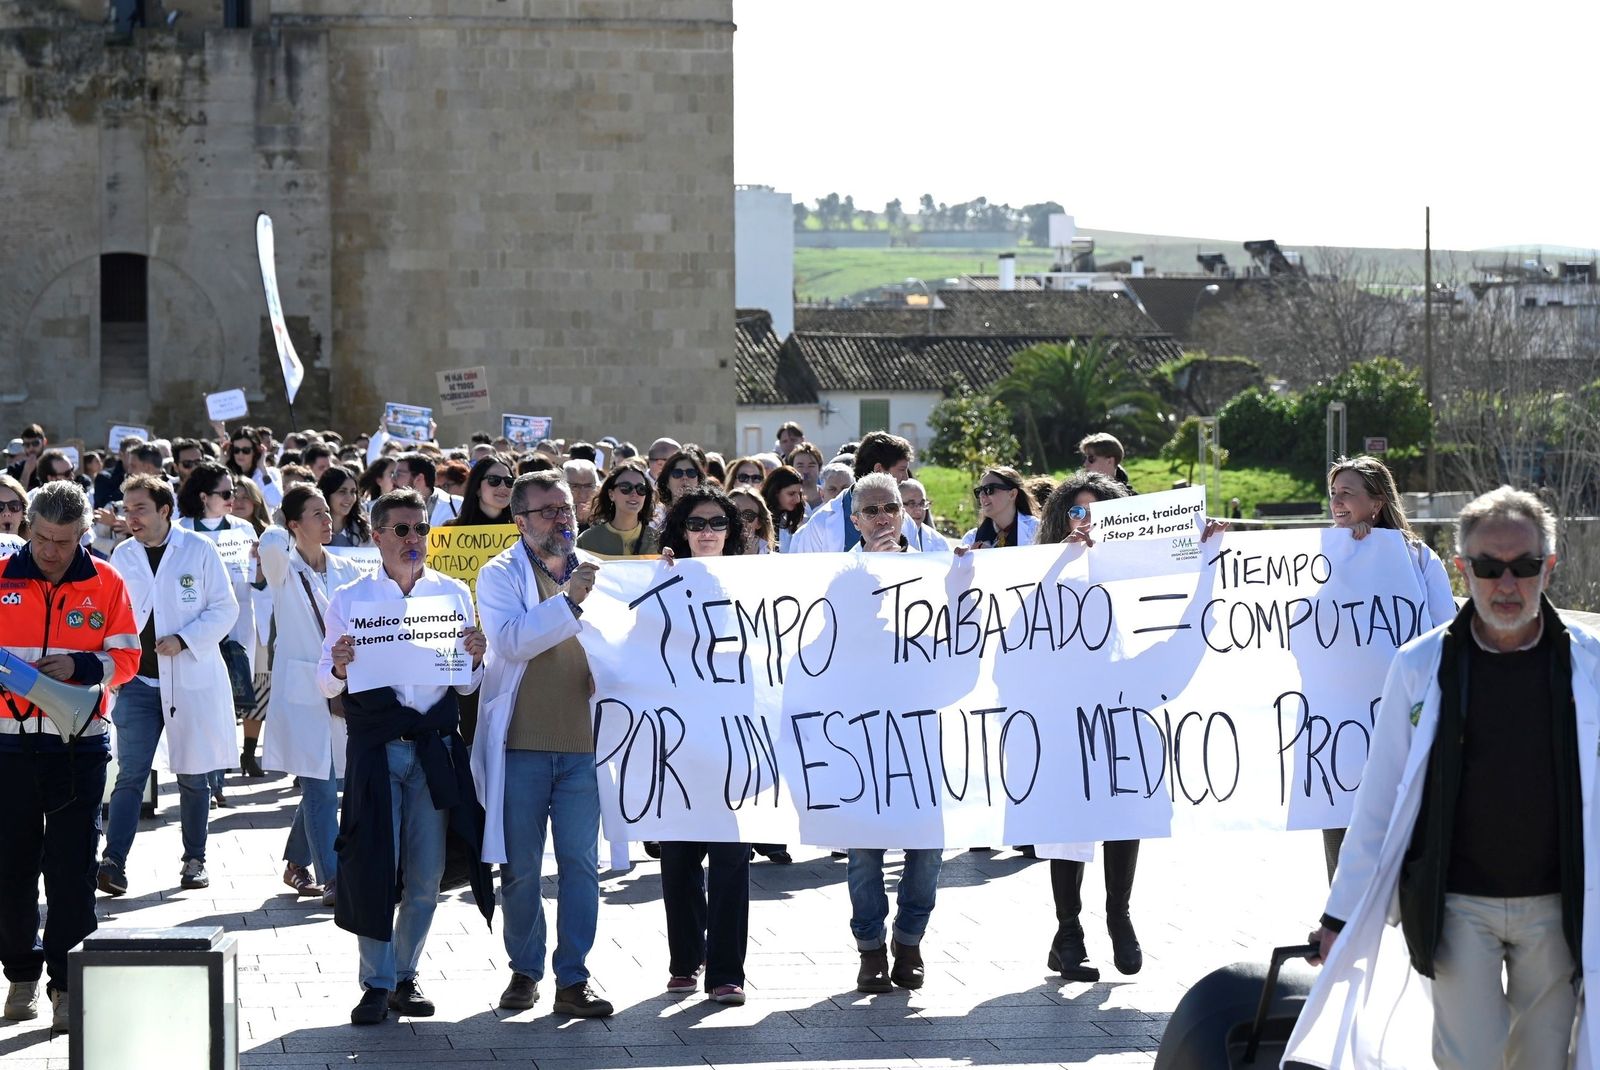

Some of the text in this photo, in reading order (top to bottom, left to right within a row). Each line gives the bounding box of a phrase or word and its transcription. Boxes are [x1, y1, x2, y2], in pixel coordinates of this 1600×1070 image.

[1100, 500, 1204, 530] ¡Mónica, traidora!
[431, 533, 452, 549] UN
[1103, 519, 1194, 543] ¡Stop 24 horas!
[217, 539, 241, 548] endo,
[350, 609, 467, 630] “Médico quemado,
[872, 577, 1113, 664] TRABAJADO
[348, 634, 394, 647] istema
[594, 697, 692, 824] POR
[720, 715, 780, 811] UN
[790, 706, 1041, 815] ESTATUTO
